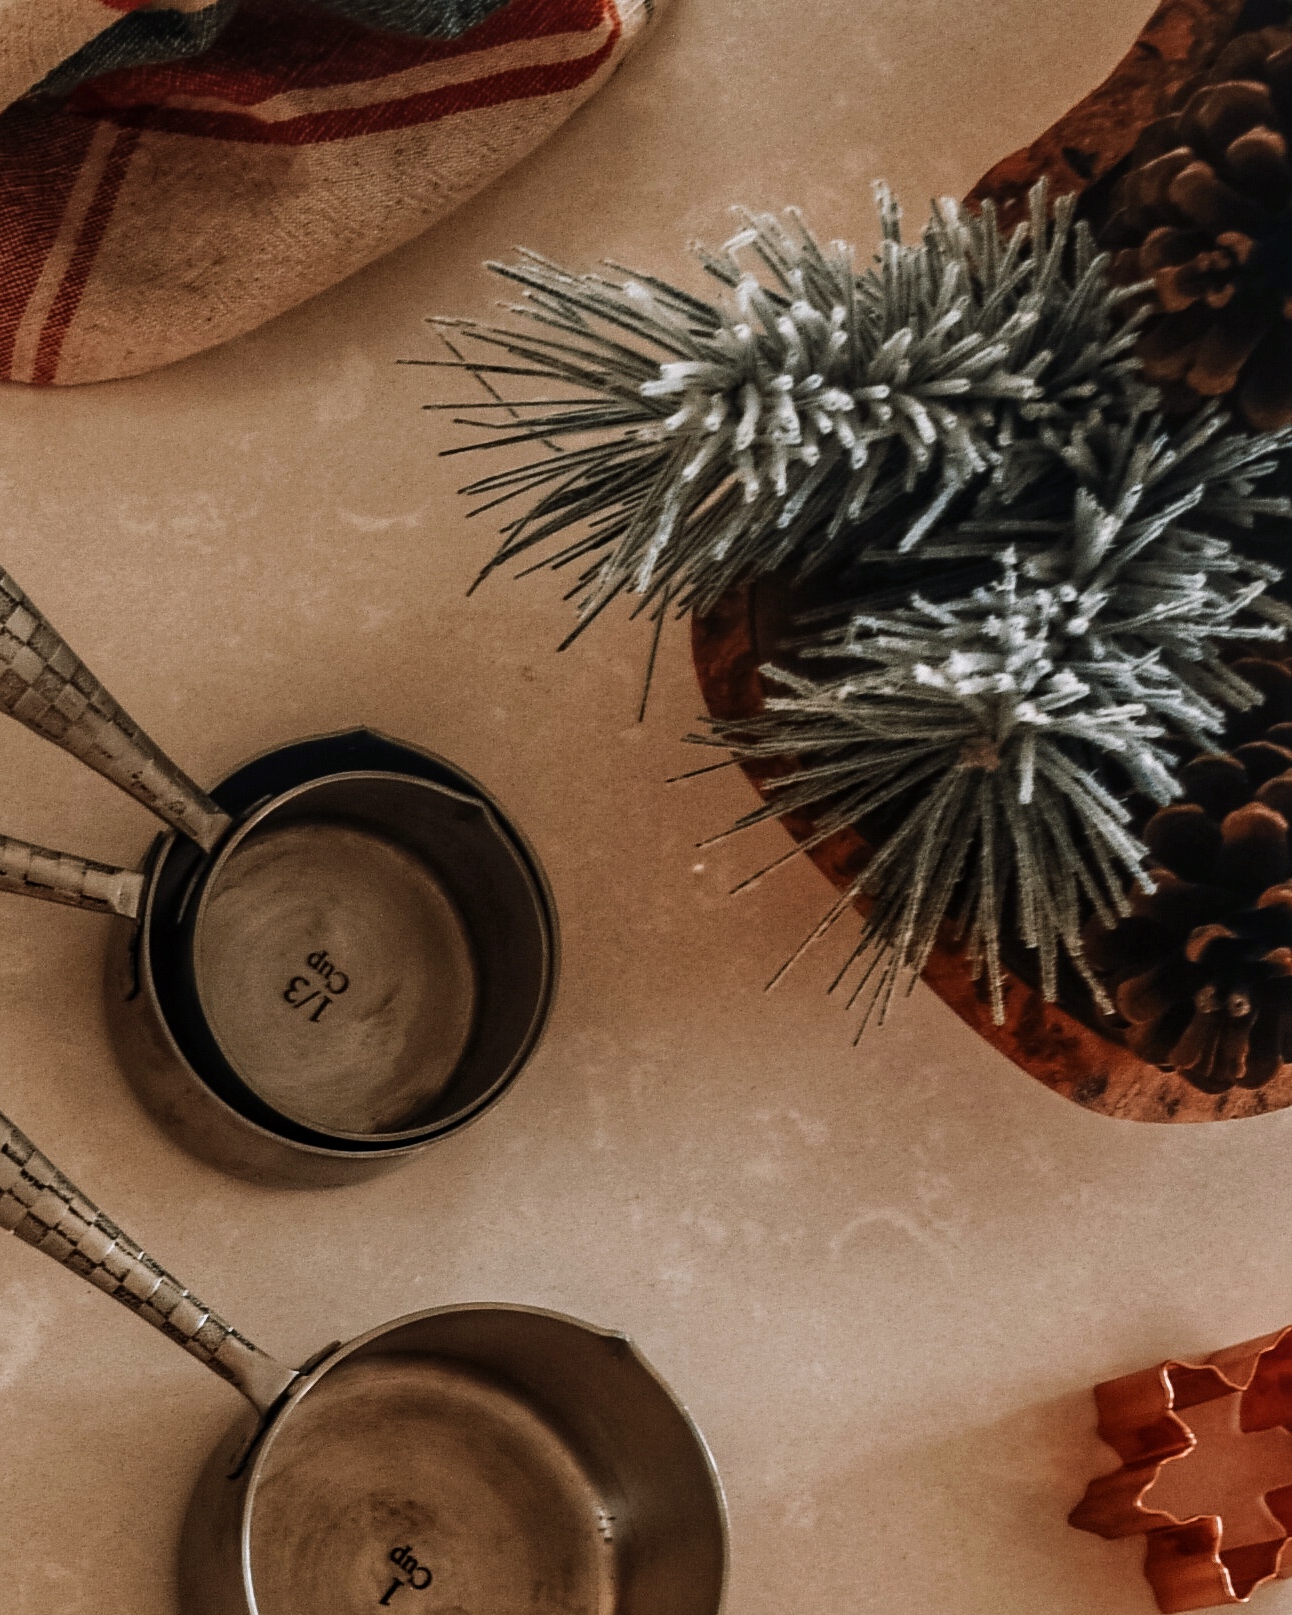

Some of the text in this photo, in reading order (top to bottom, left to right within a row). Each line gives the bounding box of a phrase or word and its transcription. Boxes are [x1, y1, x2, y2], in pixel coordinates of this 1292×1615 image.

[306, 949, 350, 995] Cup
[282, 976, 333, 1024] 1/3
[389, 1545, 433, 1590] Cup
[379, 1576, 405, 1607] 1
